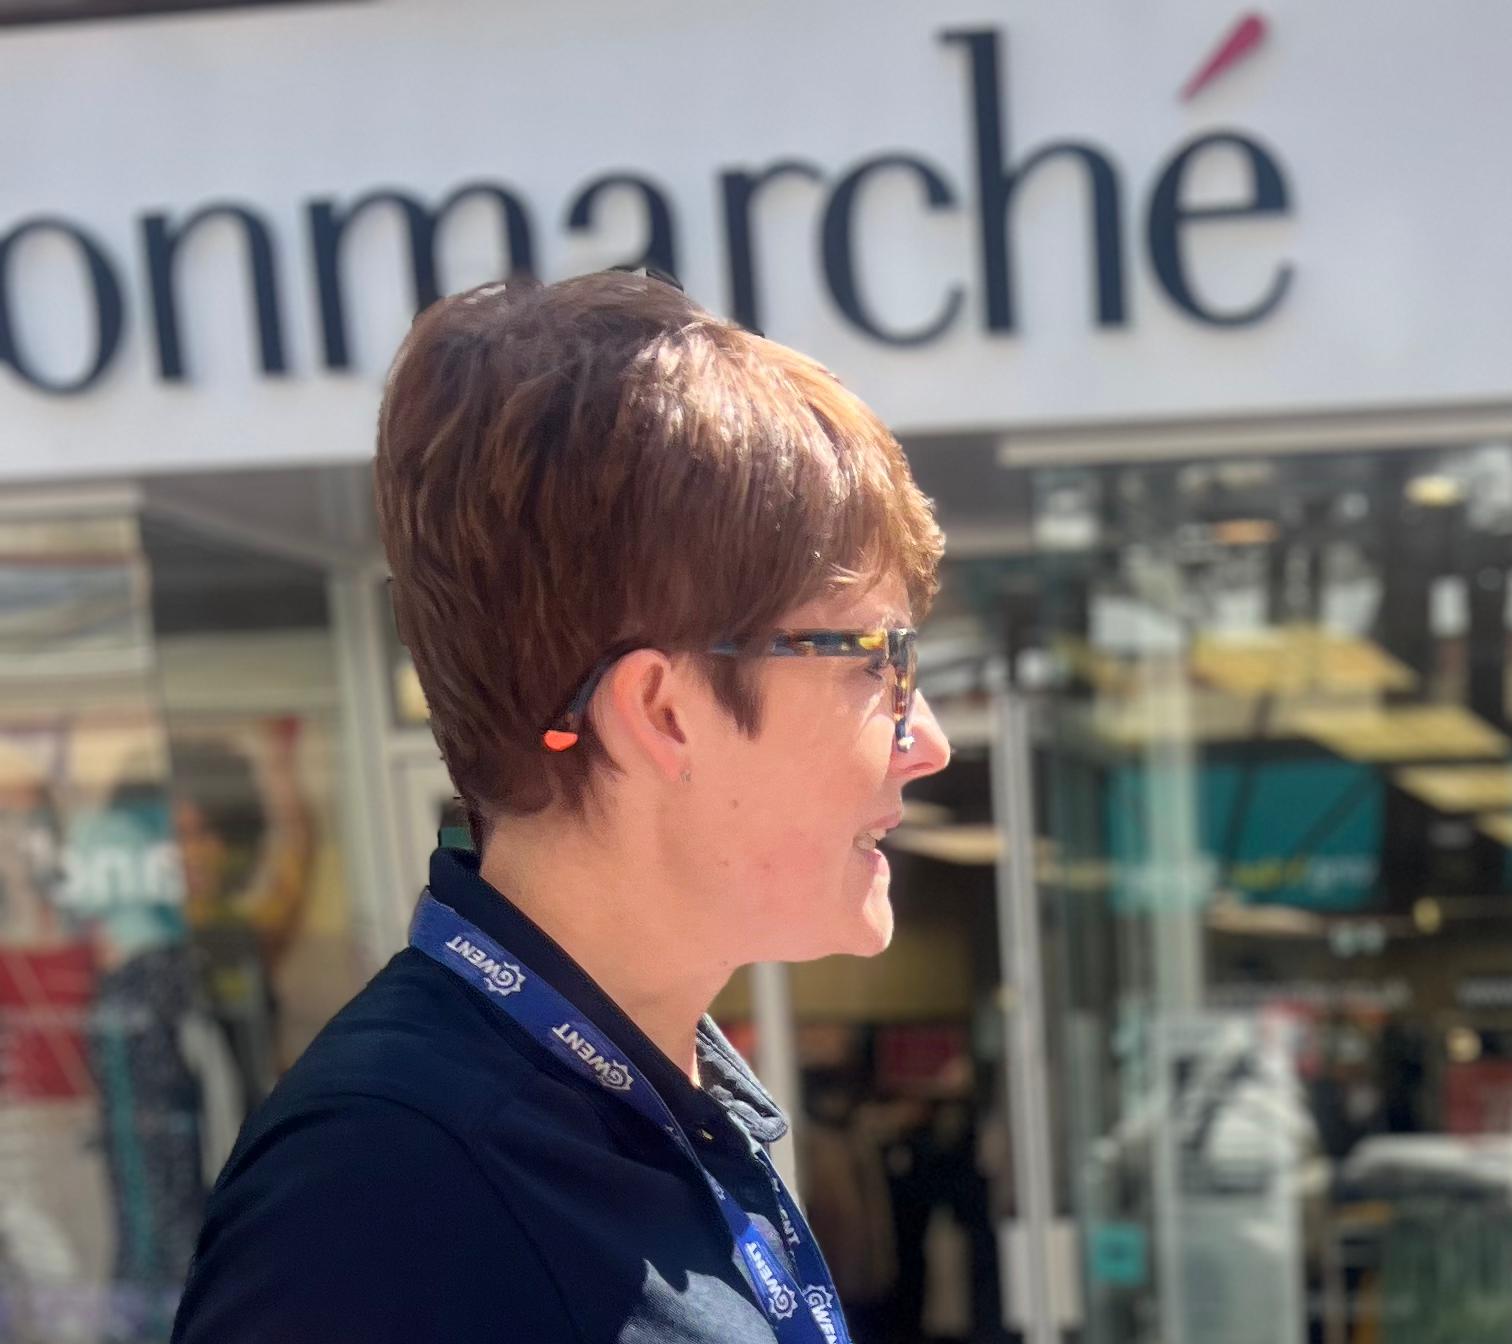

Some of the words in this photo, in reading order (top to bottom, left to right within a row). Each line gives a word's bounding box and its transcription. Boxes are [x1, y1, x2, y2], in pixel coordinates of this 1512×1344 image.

[446, 936, 513, 988] GWENT
[552, 1023, 622, 1088] GWENT
[746, 1241, 790, 1309] GWENT
